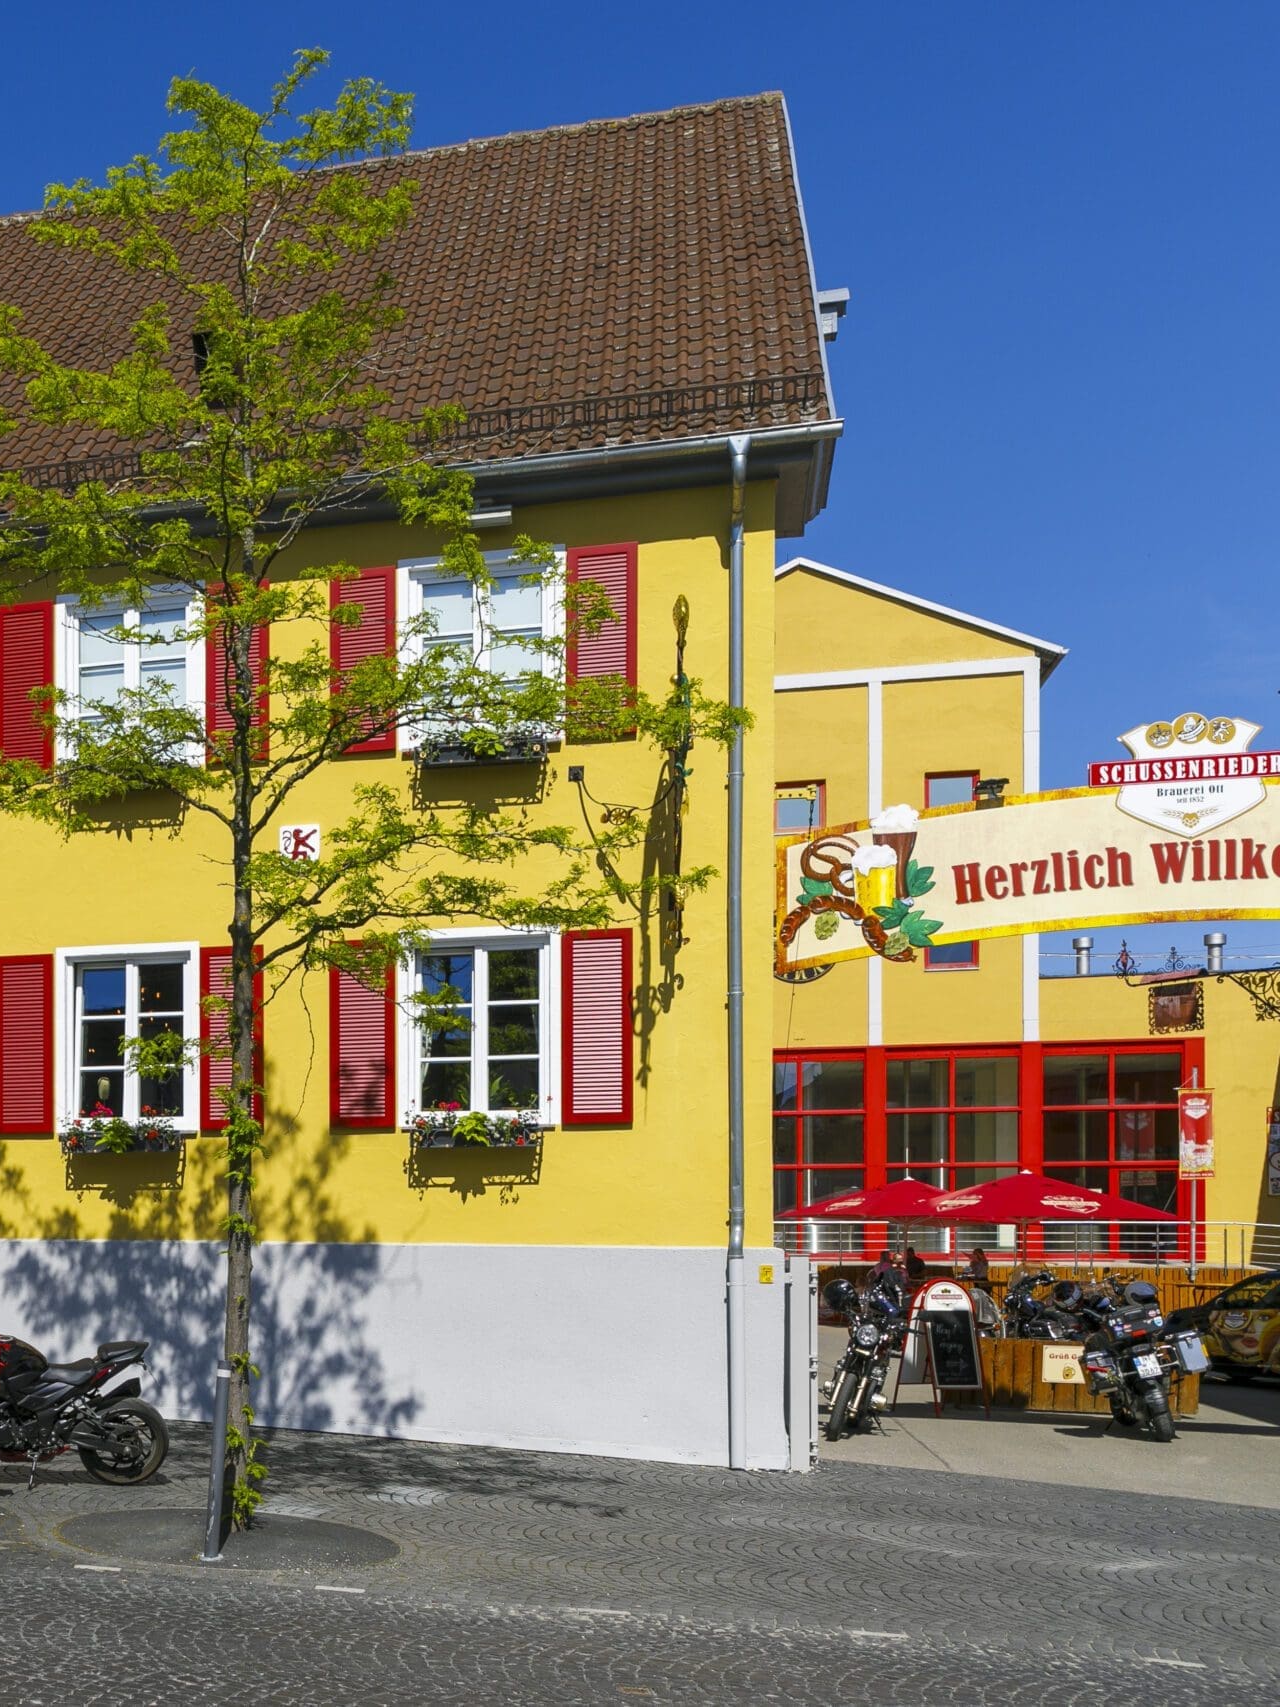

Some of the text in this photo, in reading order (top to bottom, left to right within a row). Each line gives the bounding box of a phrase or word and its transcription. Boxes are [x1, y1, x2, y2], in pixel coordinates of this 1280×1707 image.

[1099, 754, 1280, 785] SCHUSSENRIEDER
[1156, 784, 1224, 797] Brauerei Ott
[951, 846, 1135, 905] Herzlich
